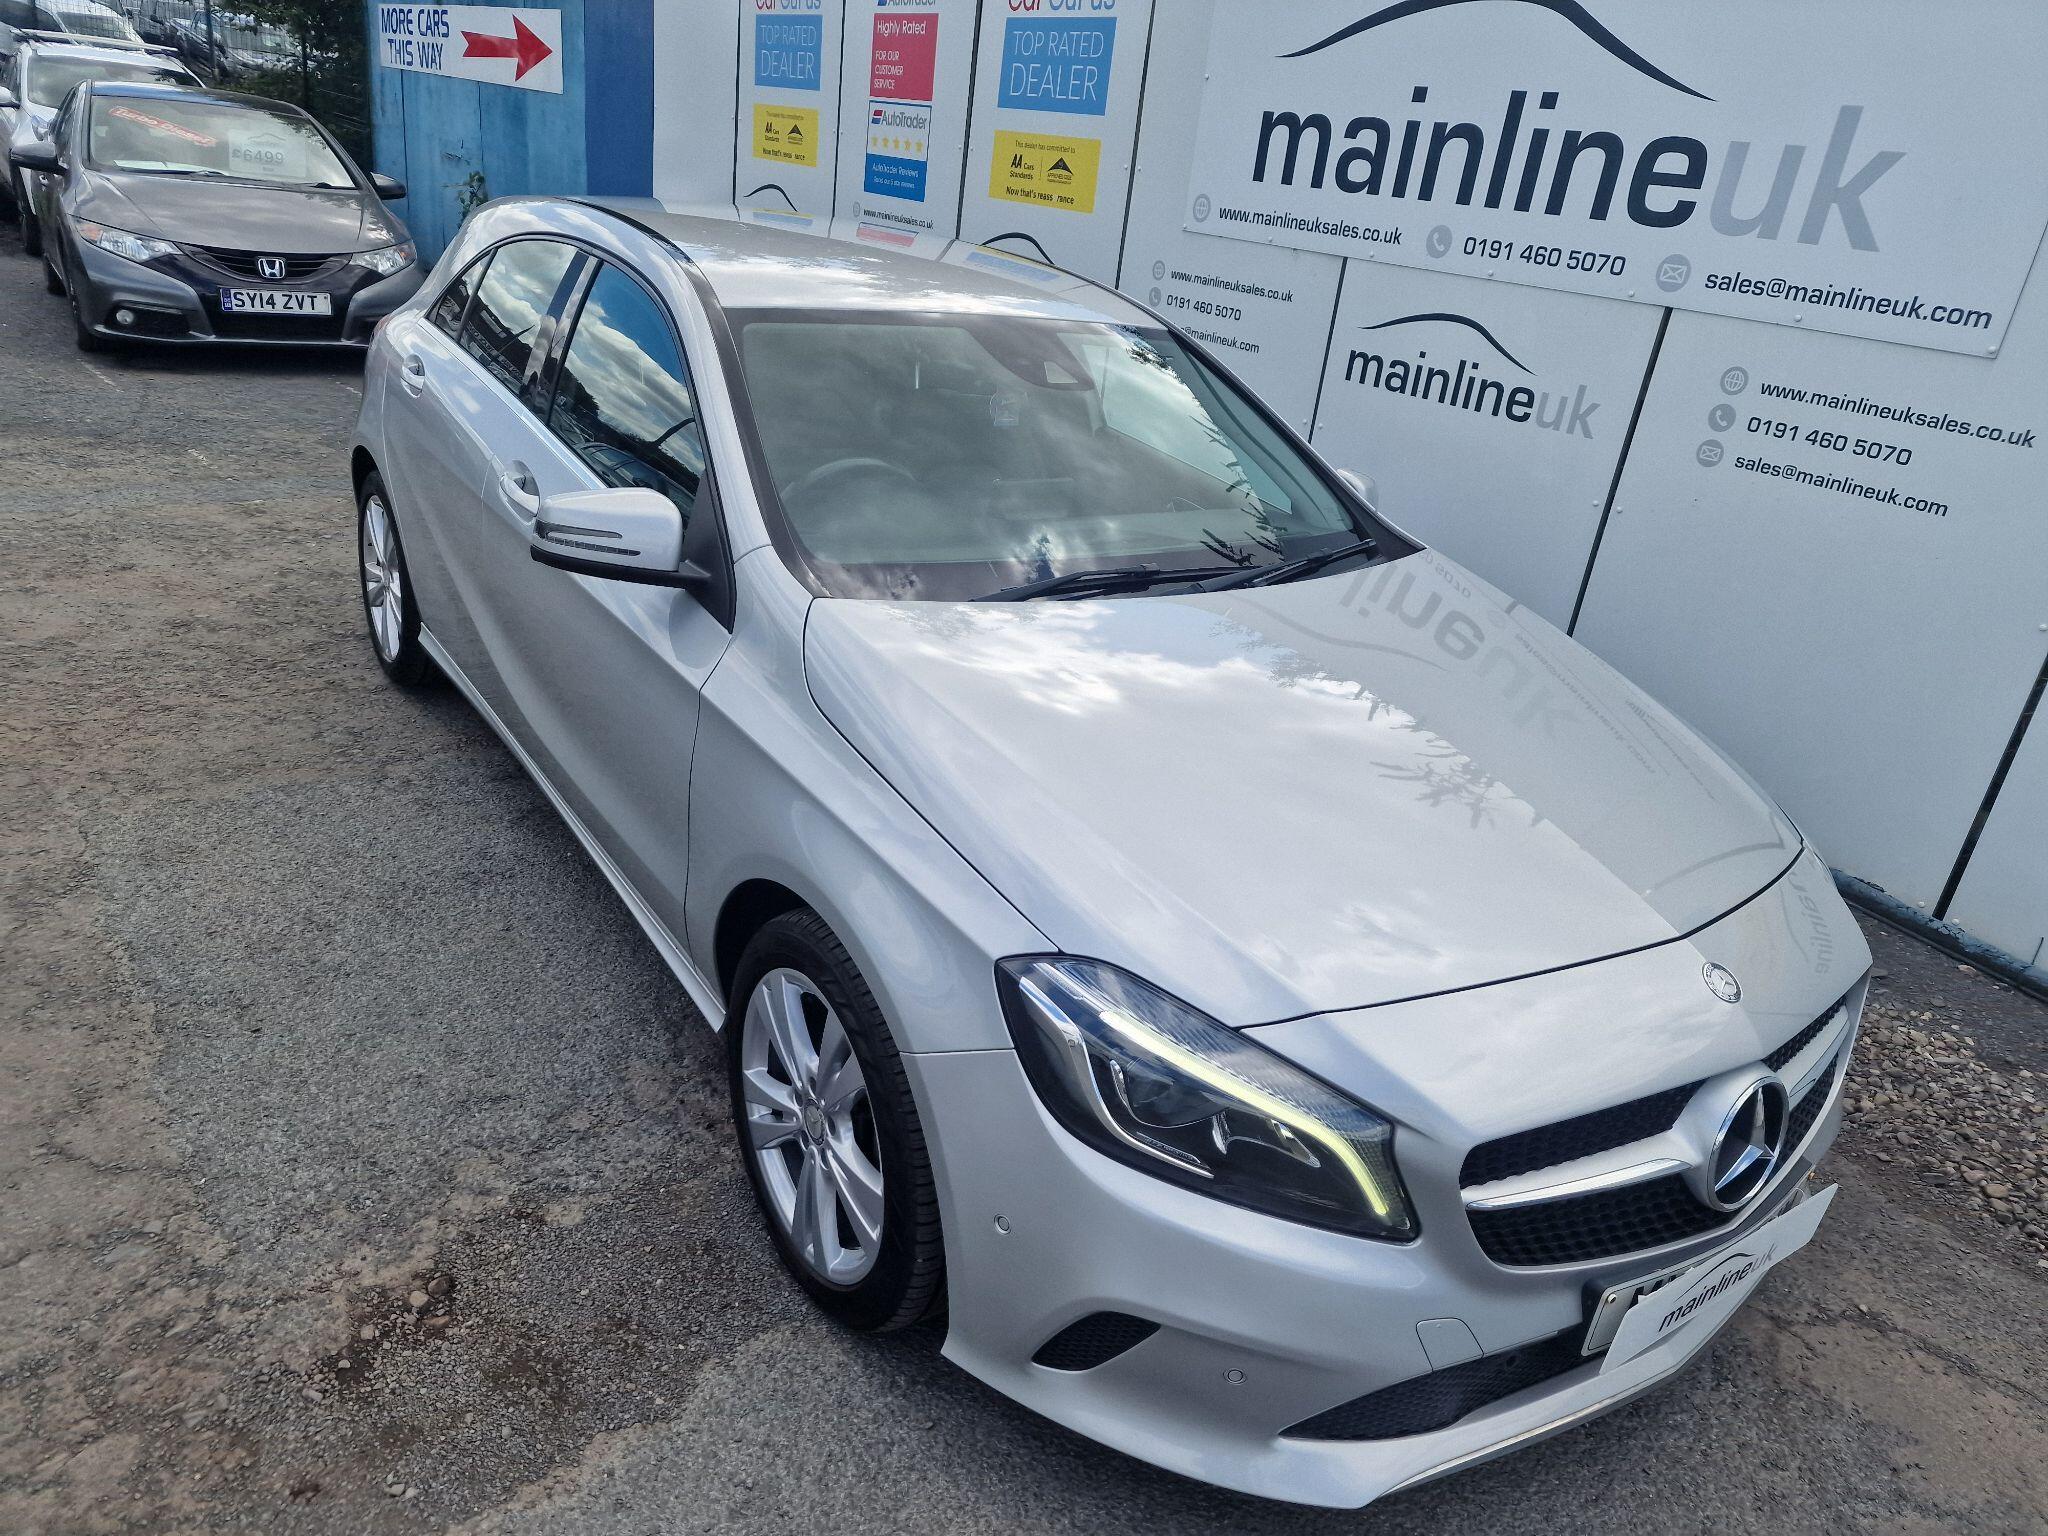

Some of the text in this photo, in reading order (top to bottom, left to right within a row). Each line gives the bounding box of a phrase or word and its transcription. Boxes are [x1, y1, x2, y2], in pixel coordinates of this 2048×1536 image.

[381, 8, 449, 38] MORE CARS
[760, 25, 817, 46] TOP RATED
[877, 20, 927, 37] Highly Rated
[388, 38, 443, 70] THIS WAY
[875, 51, 900, 61] FOR OUR
[1013, 31, 1104, 58] TOP RATED
[761, 50, 815, 79] DEALER
[874, 64, 904, 76] CUSTOMER
[874, 78, 895, 90] SERVICE
[1010, 63, 1098, 101] DEALER
[881, 110, 928, 130] AutoTrader
[231, 147, 284, 165] £6499
[1010, 153, 1035, 171] AA Cars
[1251, 86, 1907, 253] mainlineuk
[1009, 170, 1034, 181] Standards
[1006, 185, 1019, 196] Now
[1019, 188, 1037, 199] that's
[1219, 207, 1402, 245] www.mainlineuksales.co.uk
[1463, 236, 1627, 276] 0191 460 5070
[1171, 269, 1294, 302] www.mainlineuksales.co.uk
[233, 291, 277, 309] SY14
[281, 293, 318, 311] ZVT
[1166, 294, 1242, 321] 0191 460 5070
[1704, 272, 1993, 330] sales@mainlineuk.com
[1344, 350, 1601, 440] mainlineuk
[1760, 382, 2036, 448] www.mainlineuksales.co.uk
[1747, 416, 1913, 466] 0191 460 5070
[1734, 455, 1949, 517] sales@mainlineuk.com
[1658, 1243, 1778, 1333] mainlineuk
